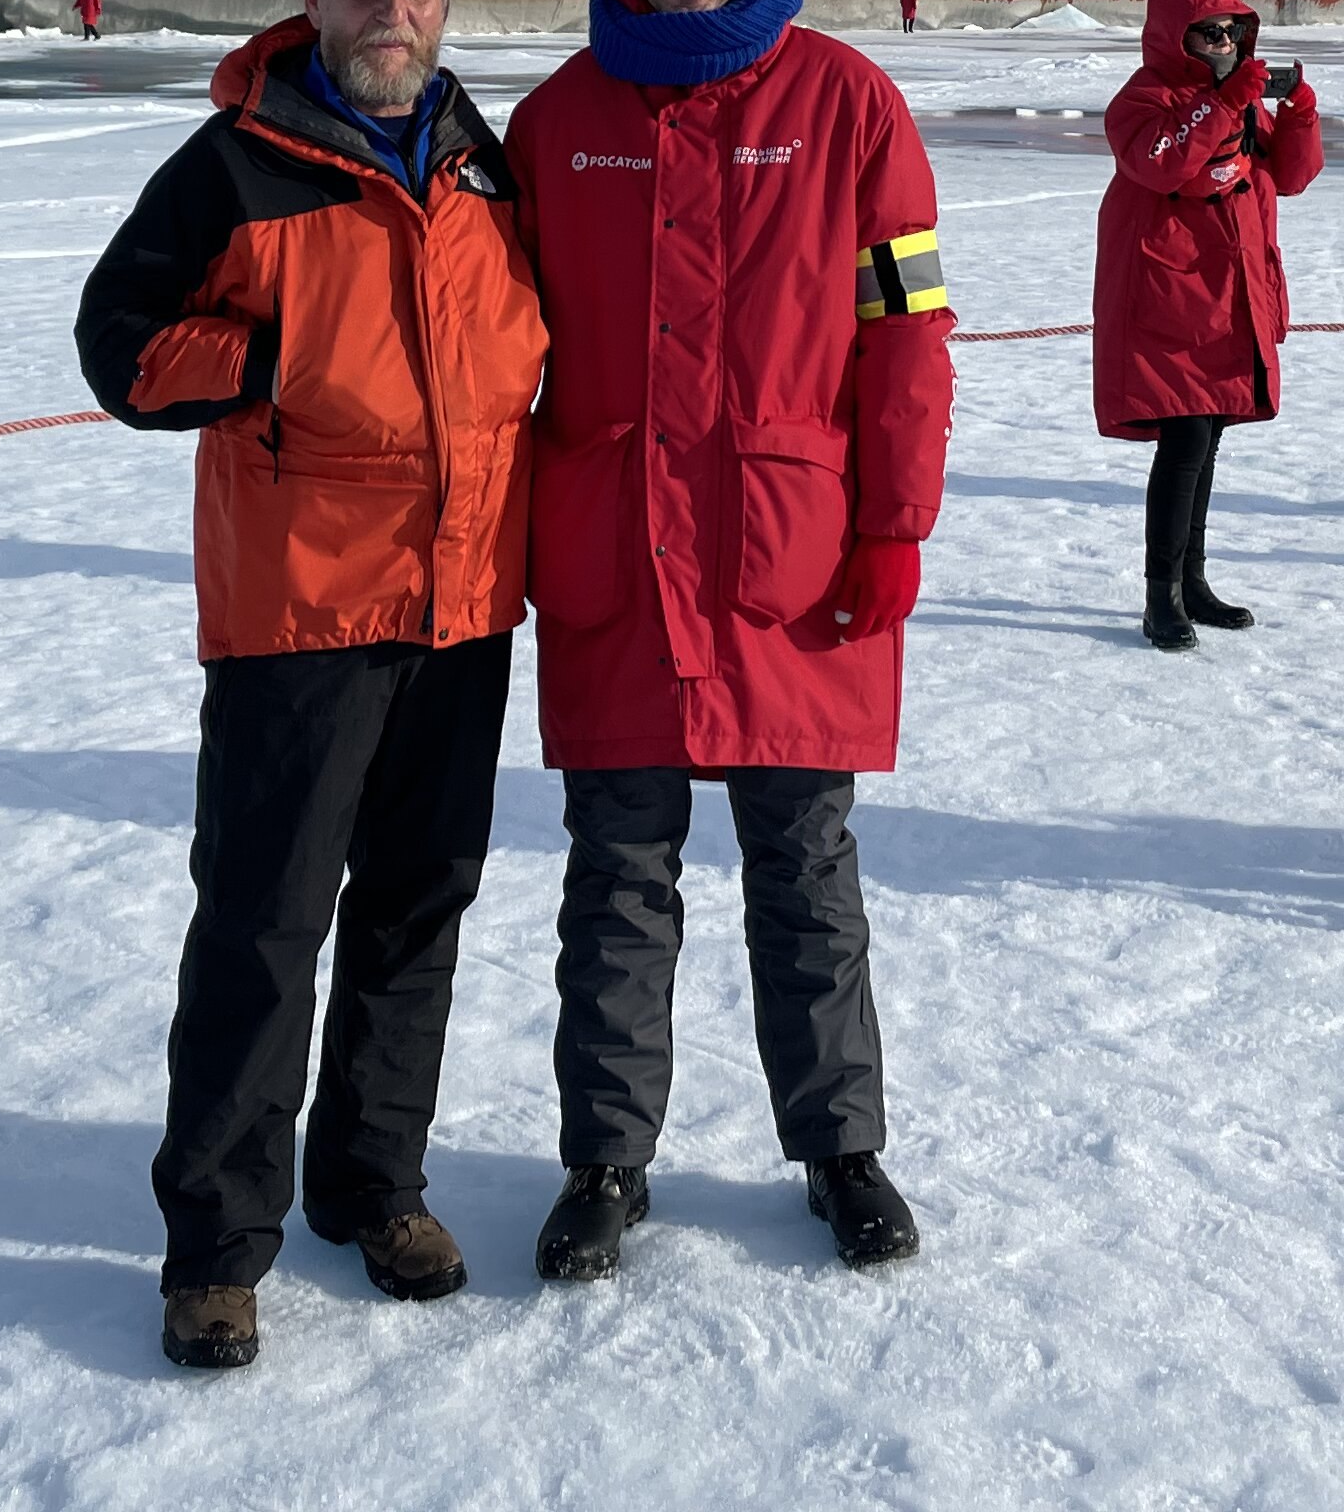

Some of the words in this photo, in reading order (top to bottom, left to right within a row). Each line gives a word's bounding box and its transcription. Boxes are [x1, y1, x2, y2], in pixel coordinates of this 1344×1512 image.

[734, 146, 793, 157] БОЛЬШАЯ
[590, 155, 652, 170] РОСАТОМ
[732, 155, 791, 165] ПЕРЕМЕНА
